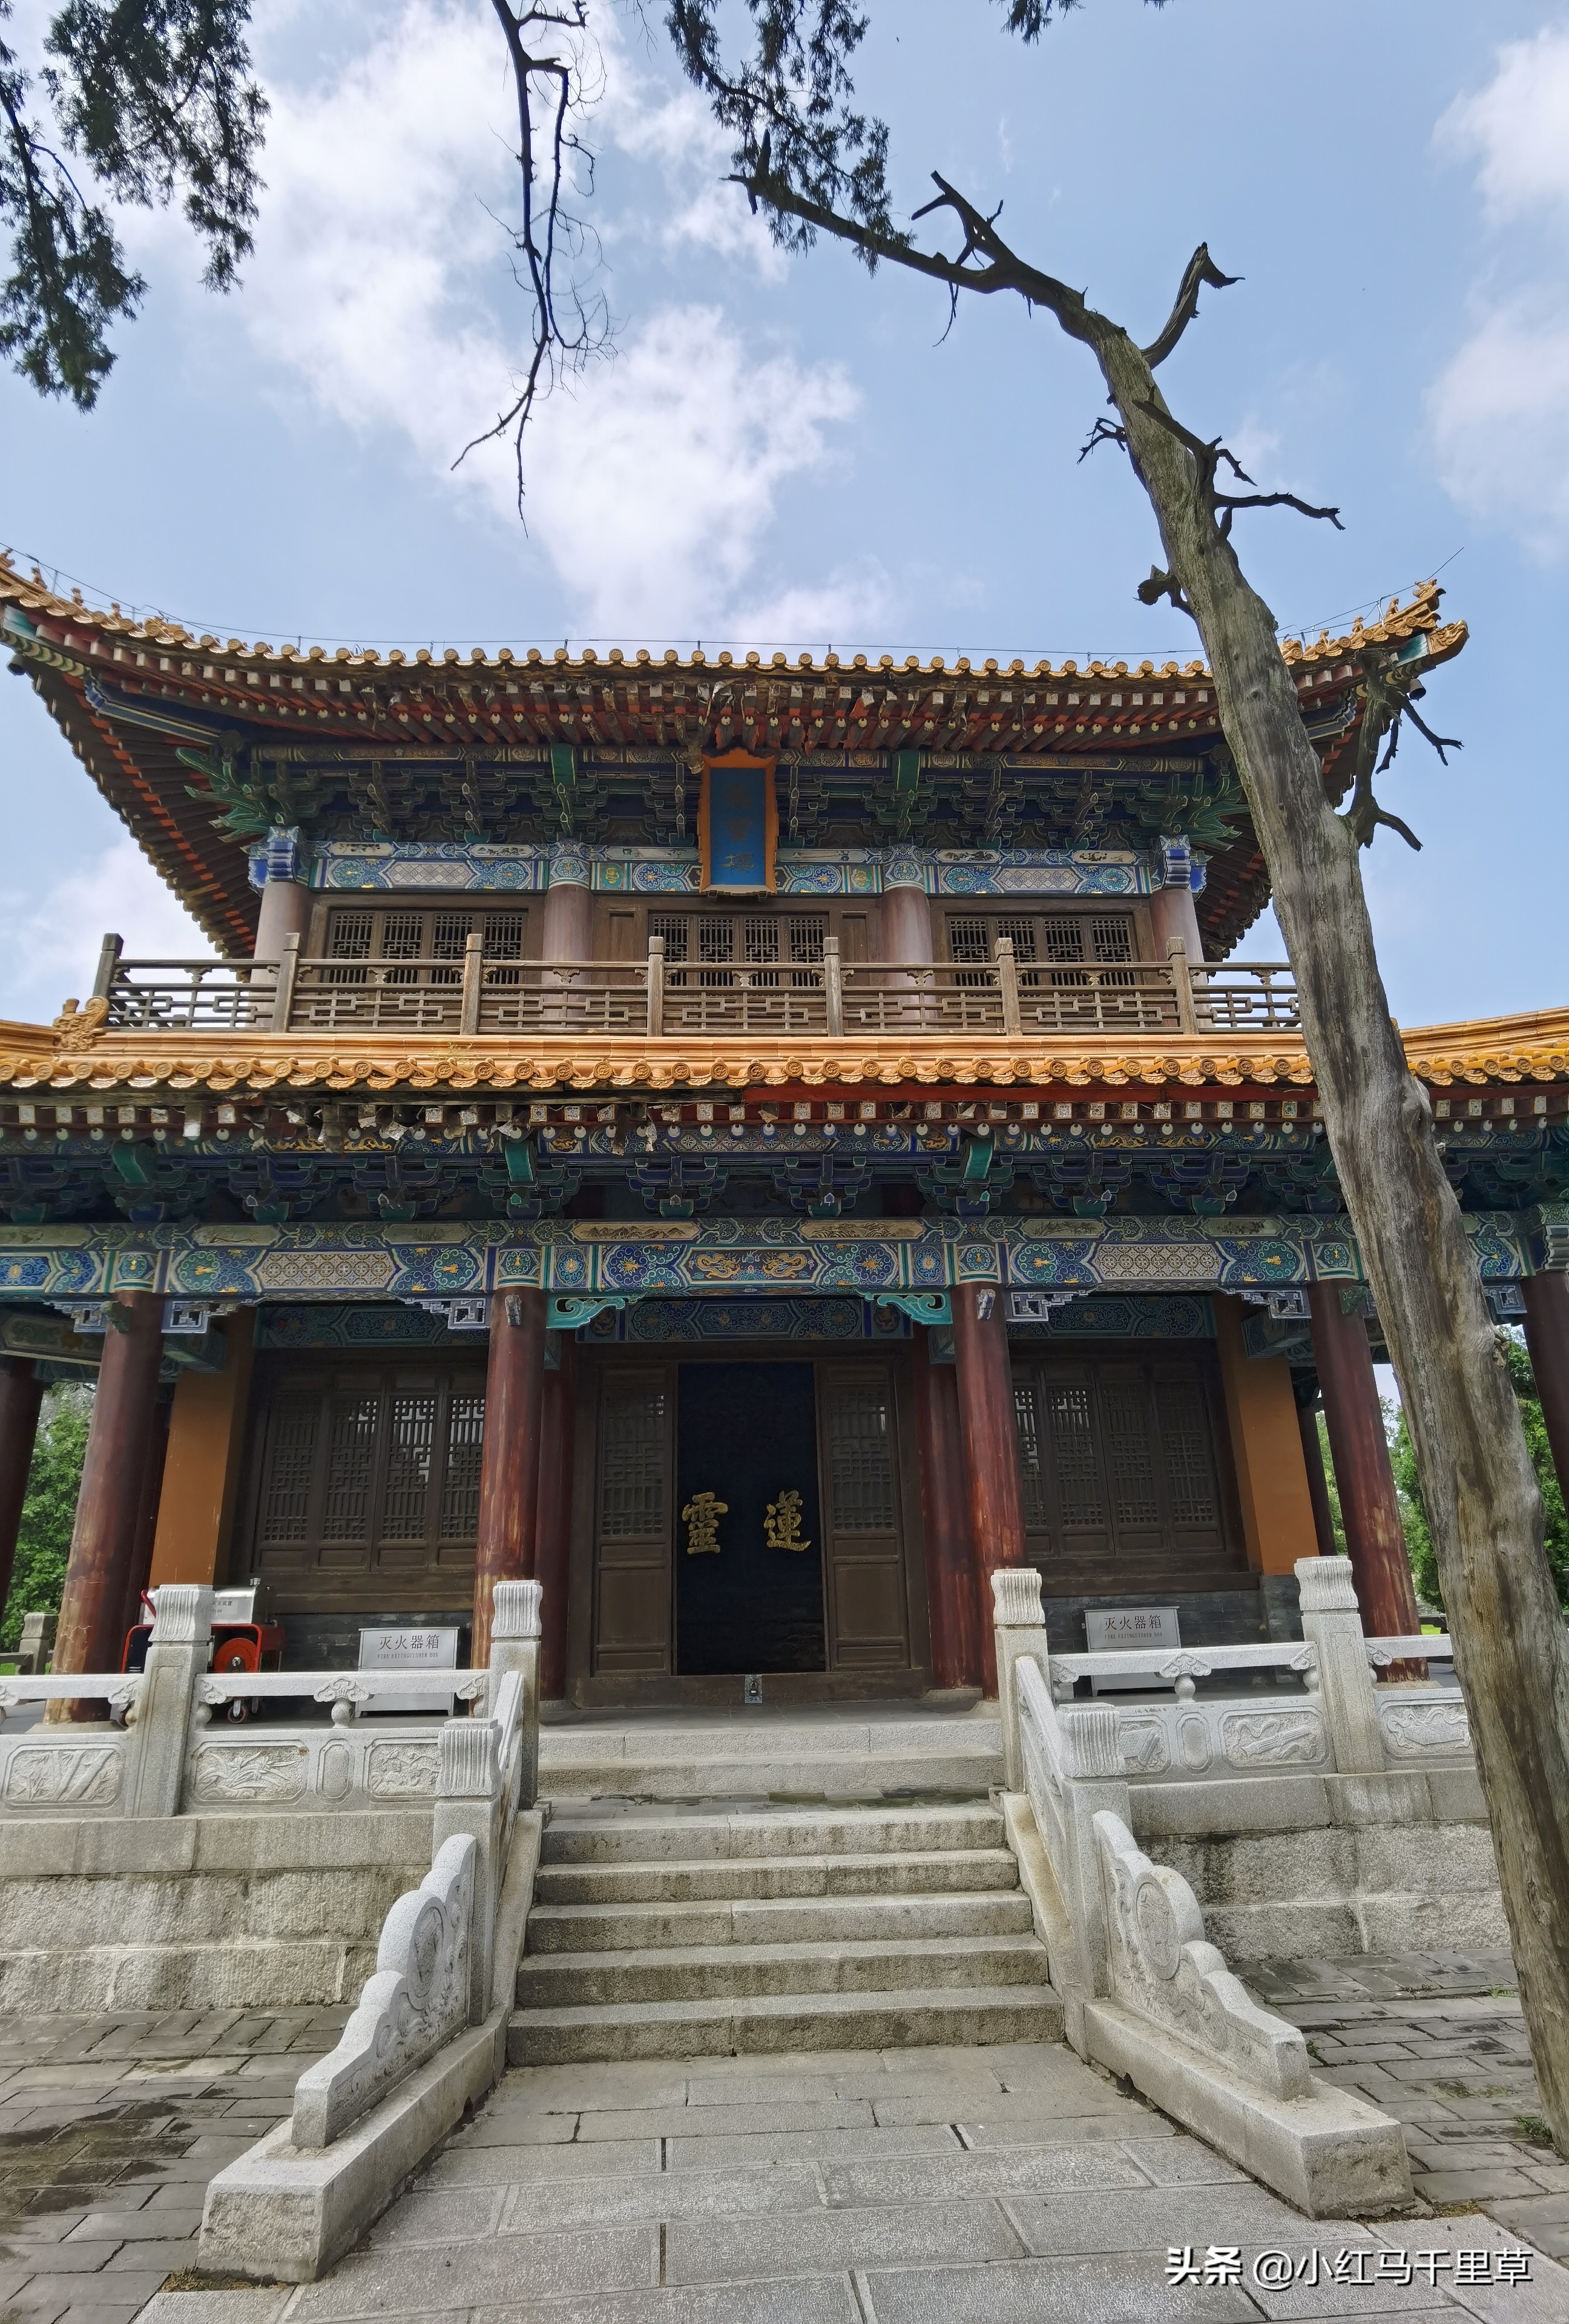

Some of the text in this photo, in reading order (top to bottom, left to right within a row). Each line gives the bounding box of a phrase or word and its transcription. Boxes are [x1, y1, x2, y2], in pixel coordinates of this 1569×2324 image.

[1104, 1614, 1161, 1631] 灭火器箱
[378, 1634, 439, 1651] 灭火器箱
